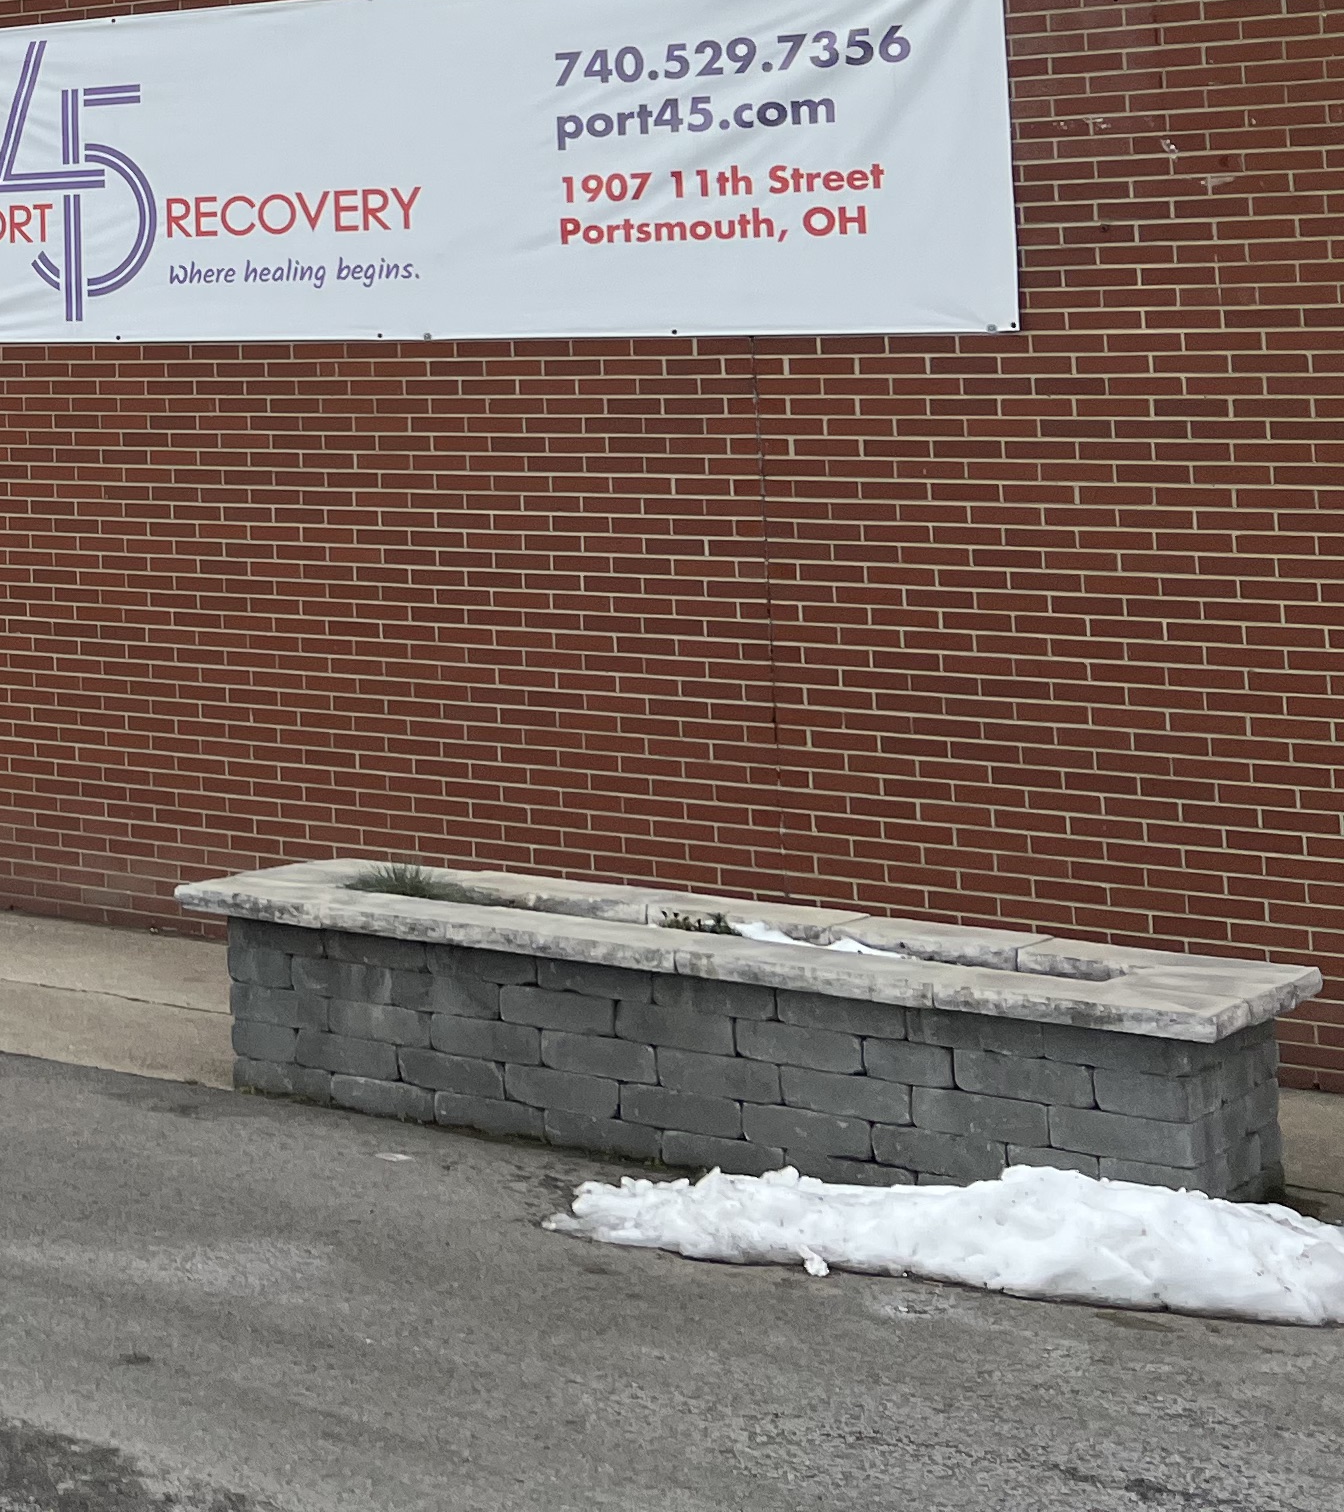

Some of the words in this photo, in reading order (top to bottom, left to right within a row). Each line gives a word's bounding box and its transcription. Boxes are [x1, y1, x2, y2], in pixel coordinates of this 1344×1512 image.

[554, 24, 912, 88] 740.529.7356
[556, 95, 836, 151] port45.com
[561, 171, 652, 203] 1907
[670, 164, 753, 199] 11th
[768, 163, 885, 195] Street
[165, 186, 422, 239] RECOVERY
[559, 207, 788, 245] Portsmouth,
[802, 205, 868, 237] OH
[169, 260, 237, 286] Where
[243, 258, 327, 289] healing
[335, 257, 421, 288] begins.
